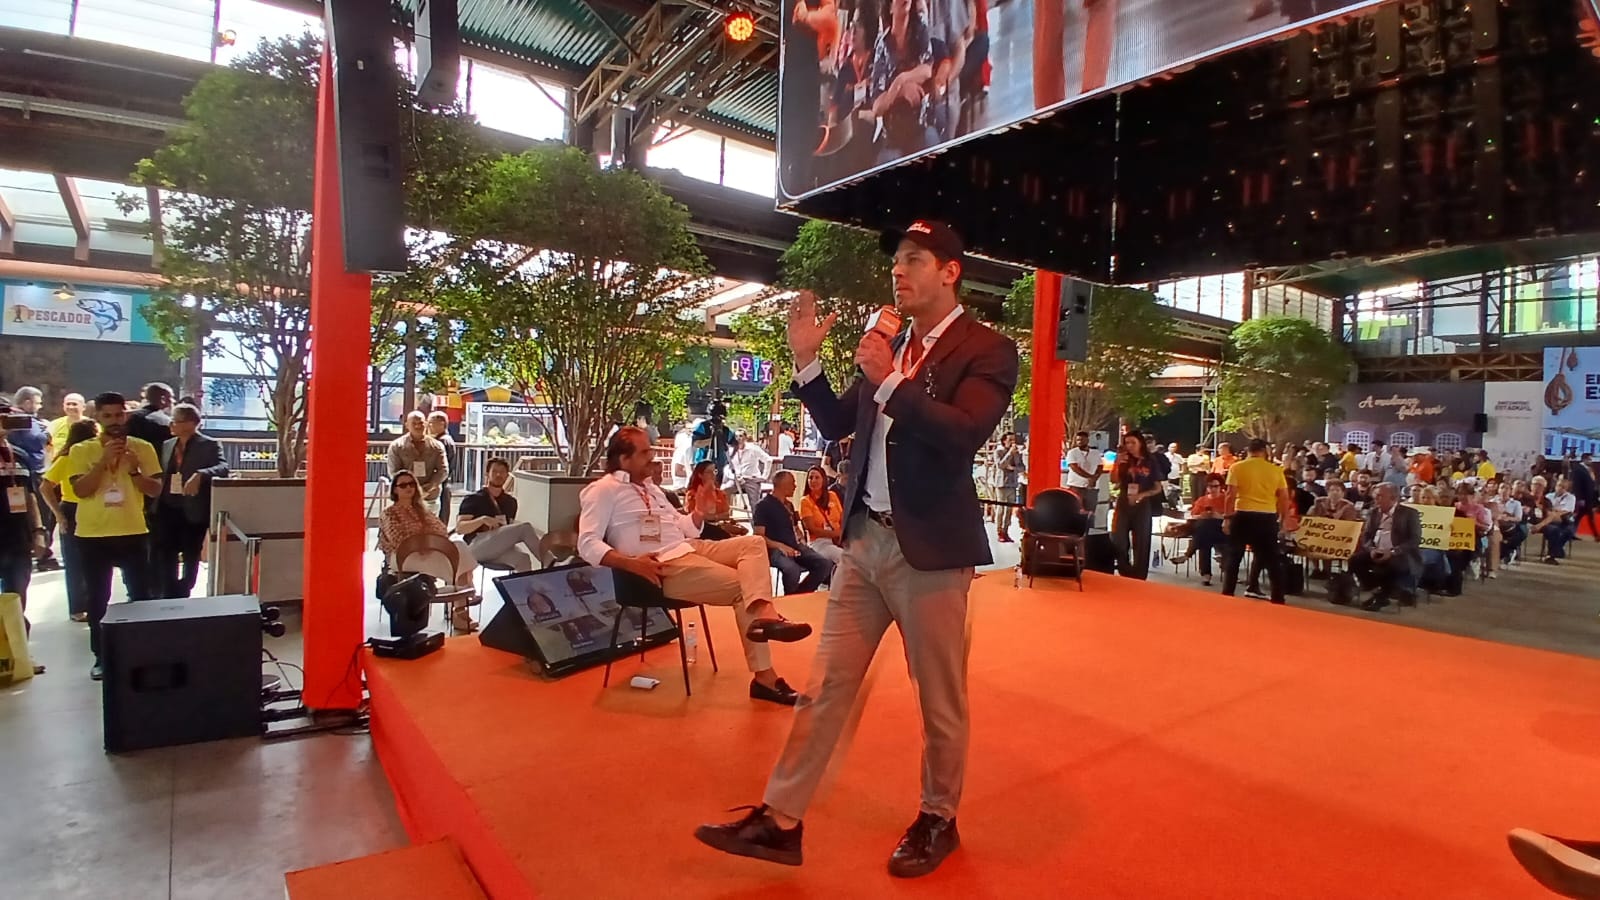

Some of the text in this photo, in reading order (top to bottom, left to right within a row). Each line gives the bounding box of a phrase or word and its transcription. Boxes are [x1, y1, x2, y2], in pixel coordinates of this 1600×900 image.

[28, 309, 92, 324] PESCADOR
[1302, 519, 1335, 531] MARCO
[1298, 537, 1351, 557] SENADOR
[1419, 537, 1441, 546] DOR
